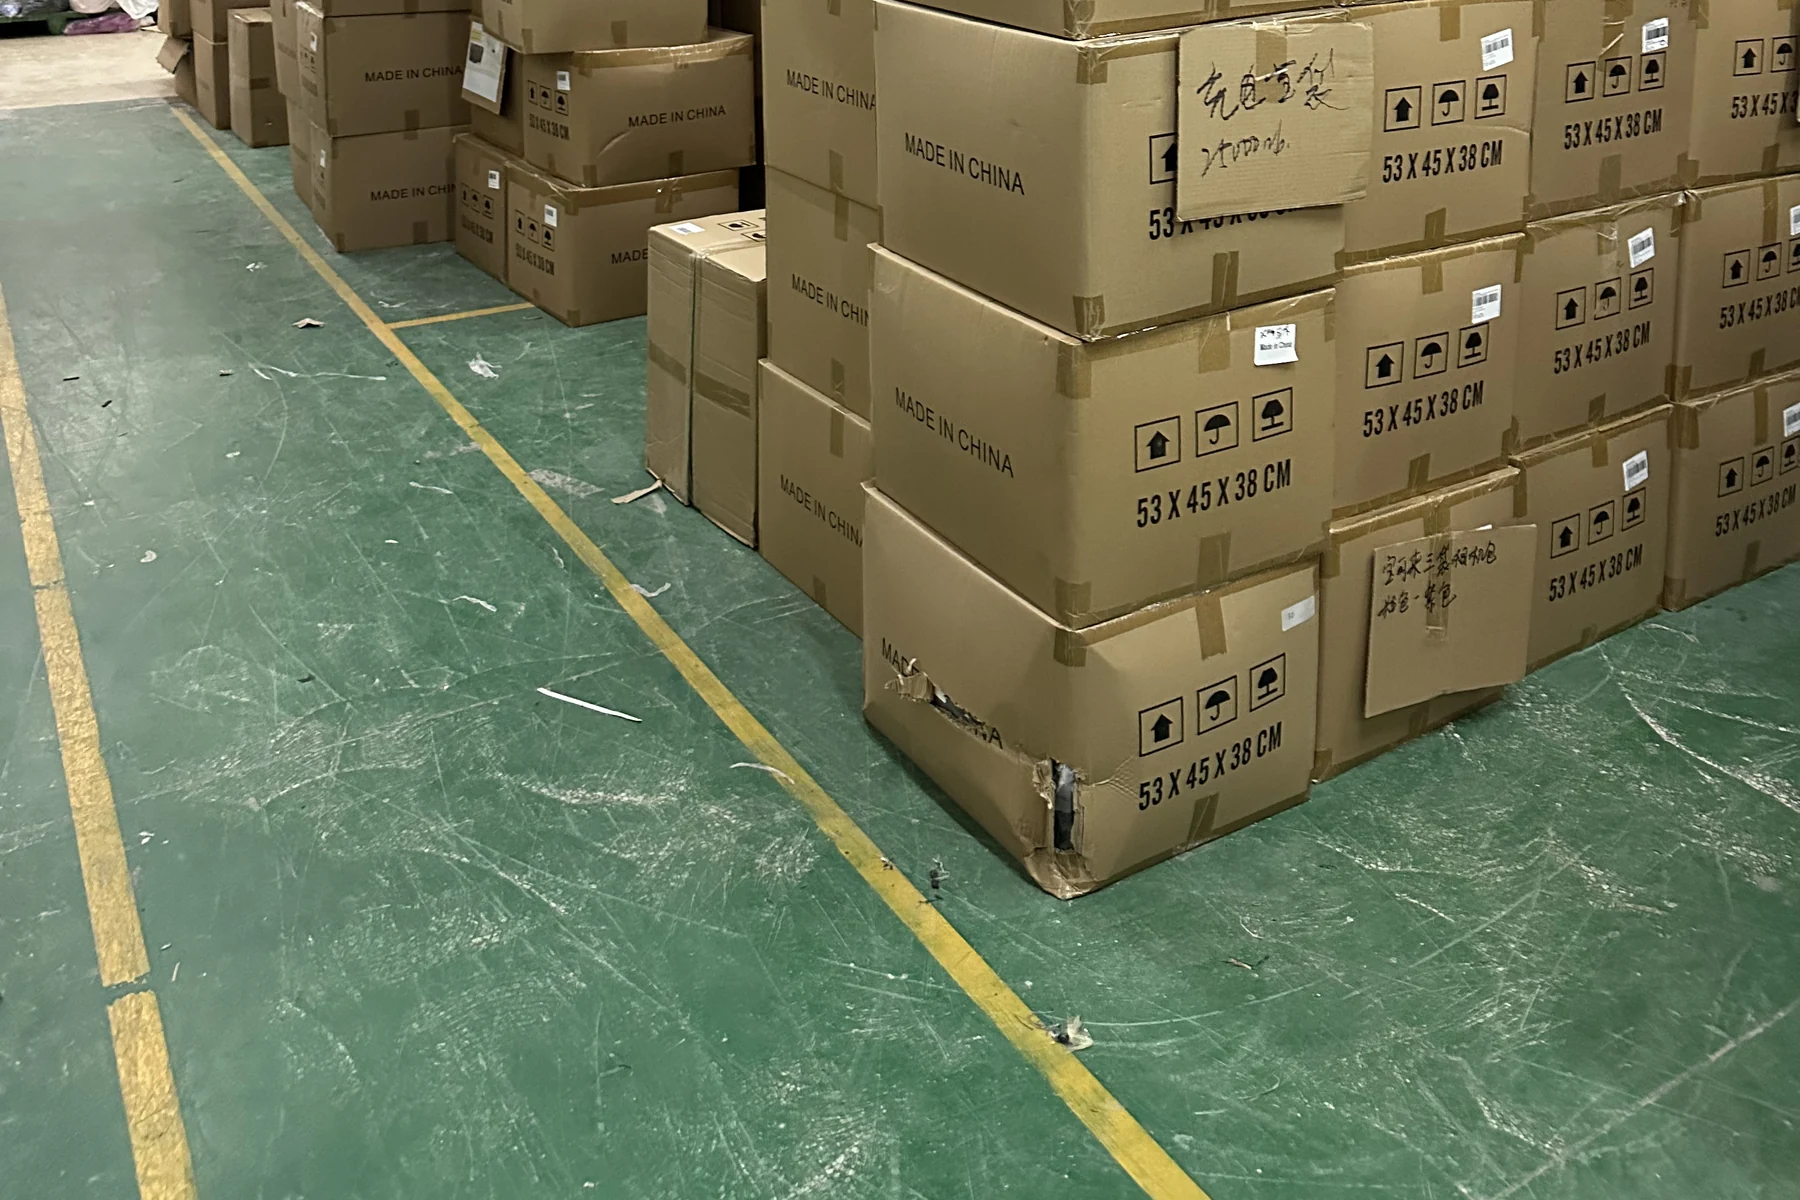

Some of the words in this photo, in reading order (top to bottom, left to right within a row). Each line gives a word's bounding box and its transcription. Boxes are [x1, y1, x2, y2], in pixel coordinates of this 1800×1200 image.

[365, 69, 402, 81] MADE
[406, 69, 419, 78] IN
[422, 65, 463, 78] CHINA
[787, 69, 819, 94] MADE
[822, 80, 833, 99] IN
[837, 85, 875, 110] CHINA
[628, 112, 667, 127] MADE
[671, 110, 683, 122] IN
[686, 105, 726, 120] CHINA
[1564, 123, 1580, 149] 53
[1583, 121, 1592, 146] X
[1595, 117, 1611, 143] 45
[1613, 115, 1623, 140] X
[1625, 112, 1640, 138] 38
[1643, 108, 1662, 134] CM
[905, 132, 945, 167] MADE
[949, 149, 964, 174] IN
[968, 157, 1024, 195] CHINA
[1382, 154, 1403, 183] 53
[1406, 152, 1418, 179] X
[1421, 149, 1442, 177] 45
[1444, 147, 1456, 173] X
[1458, 143, 1477, 171] 38
[1480, 139, 1502, 168] CM
[1149, 207, 1175, 239] 53
[792, 274, 823, 304] MADE
[827, 292, 838, 312] IN
[1554, 347, 1570, 374] 53
[1573, 343, 1583, 368] X
[1585, 337, 1602, 363] 45
[1604, 334, 1613, 358] X
[1615, 328, 1629, 354] 38
[1632, 320, 1650, 348] CM
[895, 387, 935, 430] MADE
[939, 415, 953, 443] IN
[958, 429, 1013, 478] CHINA
[1363, 408, 1383, 437] 53
[1387, 404, 1399, 431] X
[1402, 398, 1422, 426] 45
[1425, 394, 1437, 420] X
[1440, 388, 1458, 416] 38
[1462, 380, 1483, 410] CM
[781, 475, 811, 511] MADE
[815, 500, 825, 521] IN
[1137, 494, 1161, 527] 53
[1168, 489, 1180, 520] X
[1186, 481, 1211, 513] 45
[1217, 476, 1229, 506] X
[1235, 468, 1257, 501] 38
[1263, 458, 1290, 492] CM
[1716, 513, 1729, 536] 53
[1732, 509, 1740, 531] X
[1743, 503, 1756, 526] 45
[1759, 499, 1765, 518] X
[1768, 492, 1779, 515] 38
[1782, 484, 1796, 508] CM
[1549, 575, 1565, 601] 53
[1568, 570, 1577, 595] X
[1579, 563, 1596, 589] 45
[1598, 559, 1607, 583] X
[1608, 552, 1623, 578] 38
[1625, 543, 1642, 571] CM
[1139, 776, 1162, 810] 53
[1168, 768, 1181, 799] X
[1185, 756, 1209, 789] 45
[1213, 749, 1226, 778] X
[1230, 737, 1251, 770] 38
[1256, 721, 1281, 757] CM
